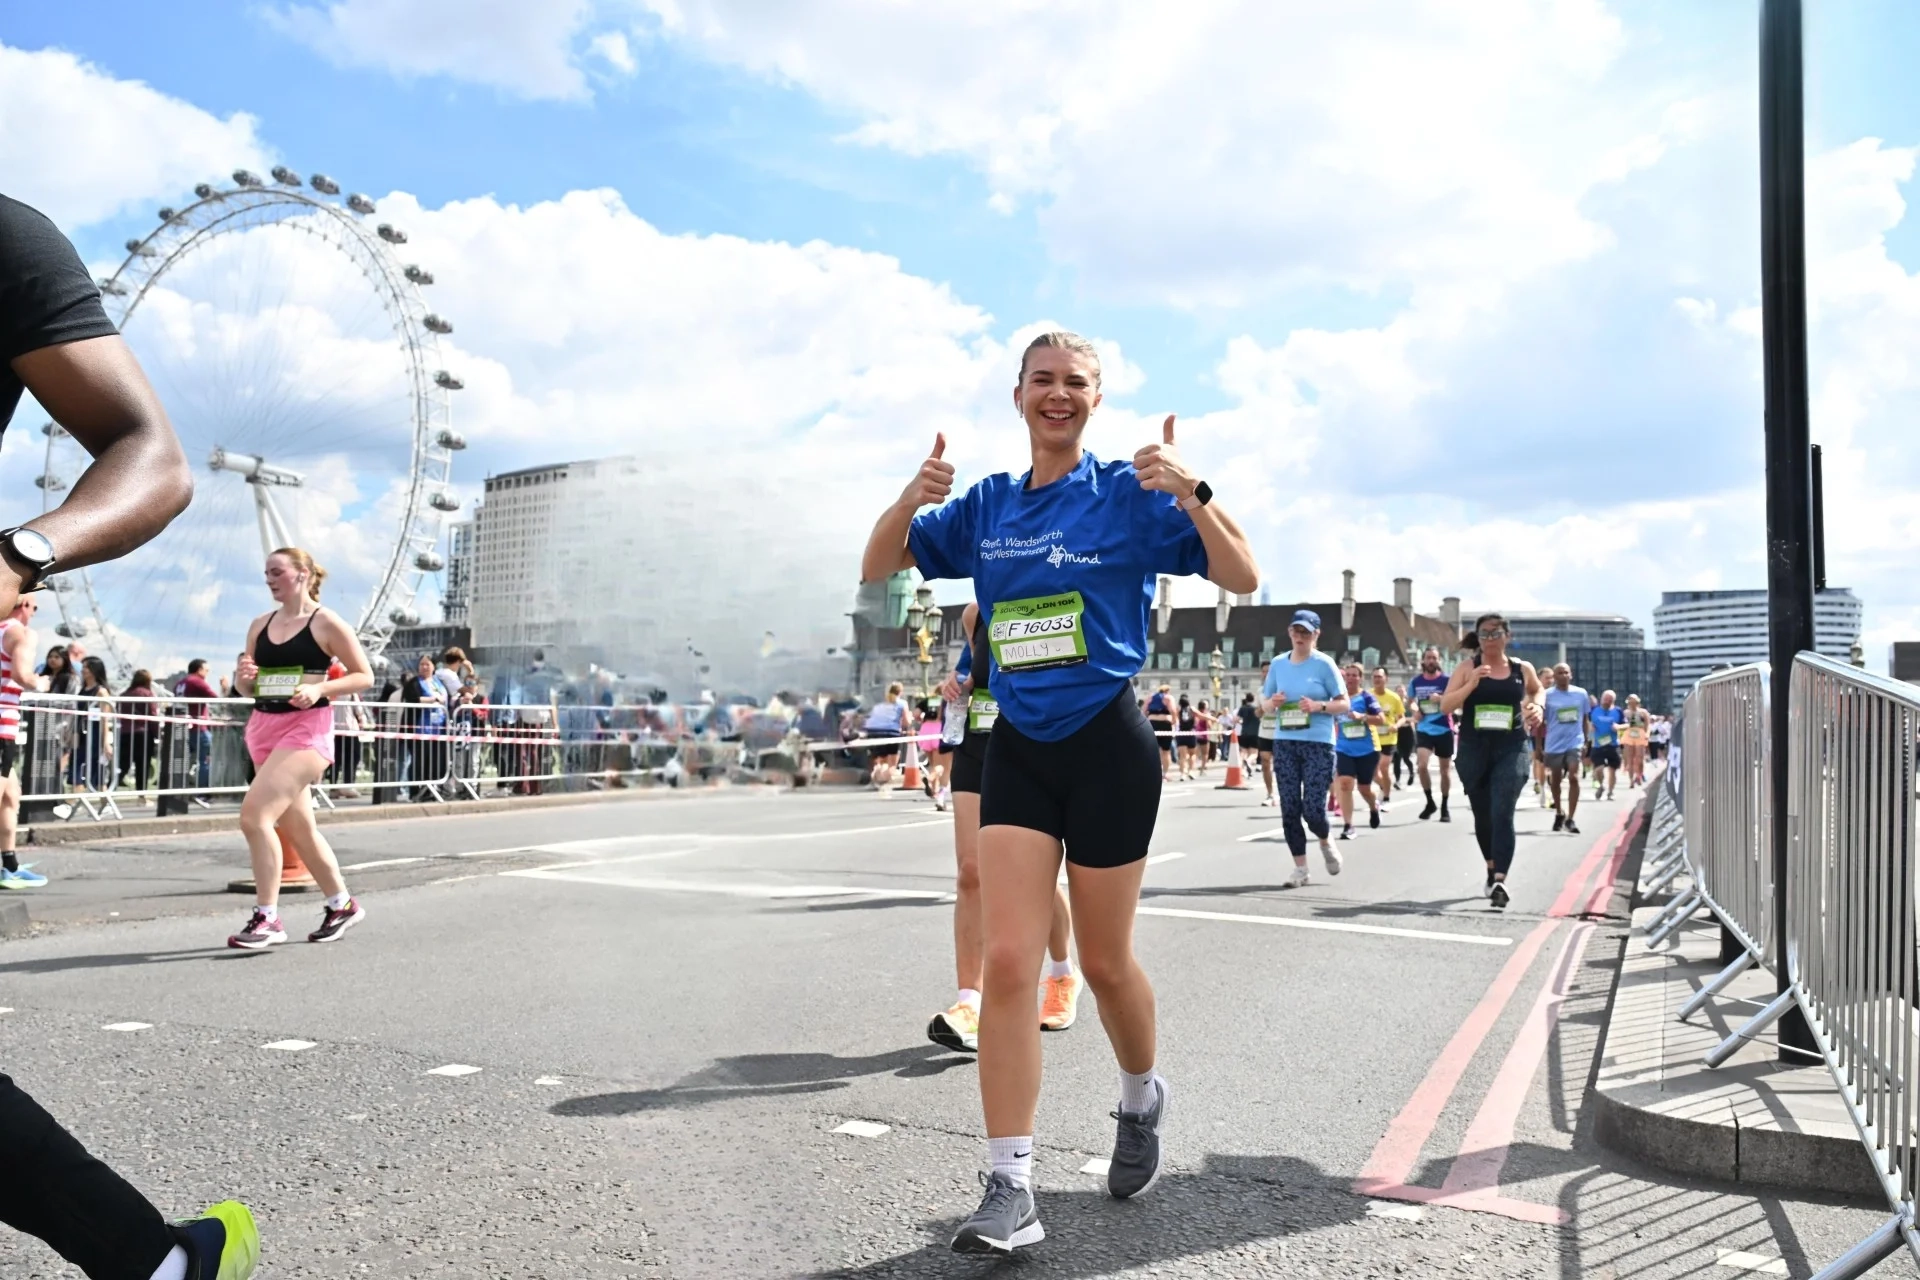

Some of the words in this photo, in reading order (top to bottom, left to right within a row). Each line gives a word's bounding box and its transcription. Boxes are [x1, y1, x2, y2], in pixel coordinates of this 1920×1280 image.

[1005, 529, 1063, 547] Wandsworth
[993, 545, 1049, 559] Westminster
[1036, 602, 1056, 610] LDN
[1057, 598, 1075, 607] 10K
[1005, 642, 1049, 661] MOLLY
